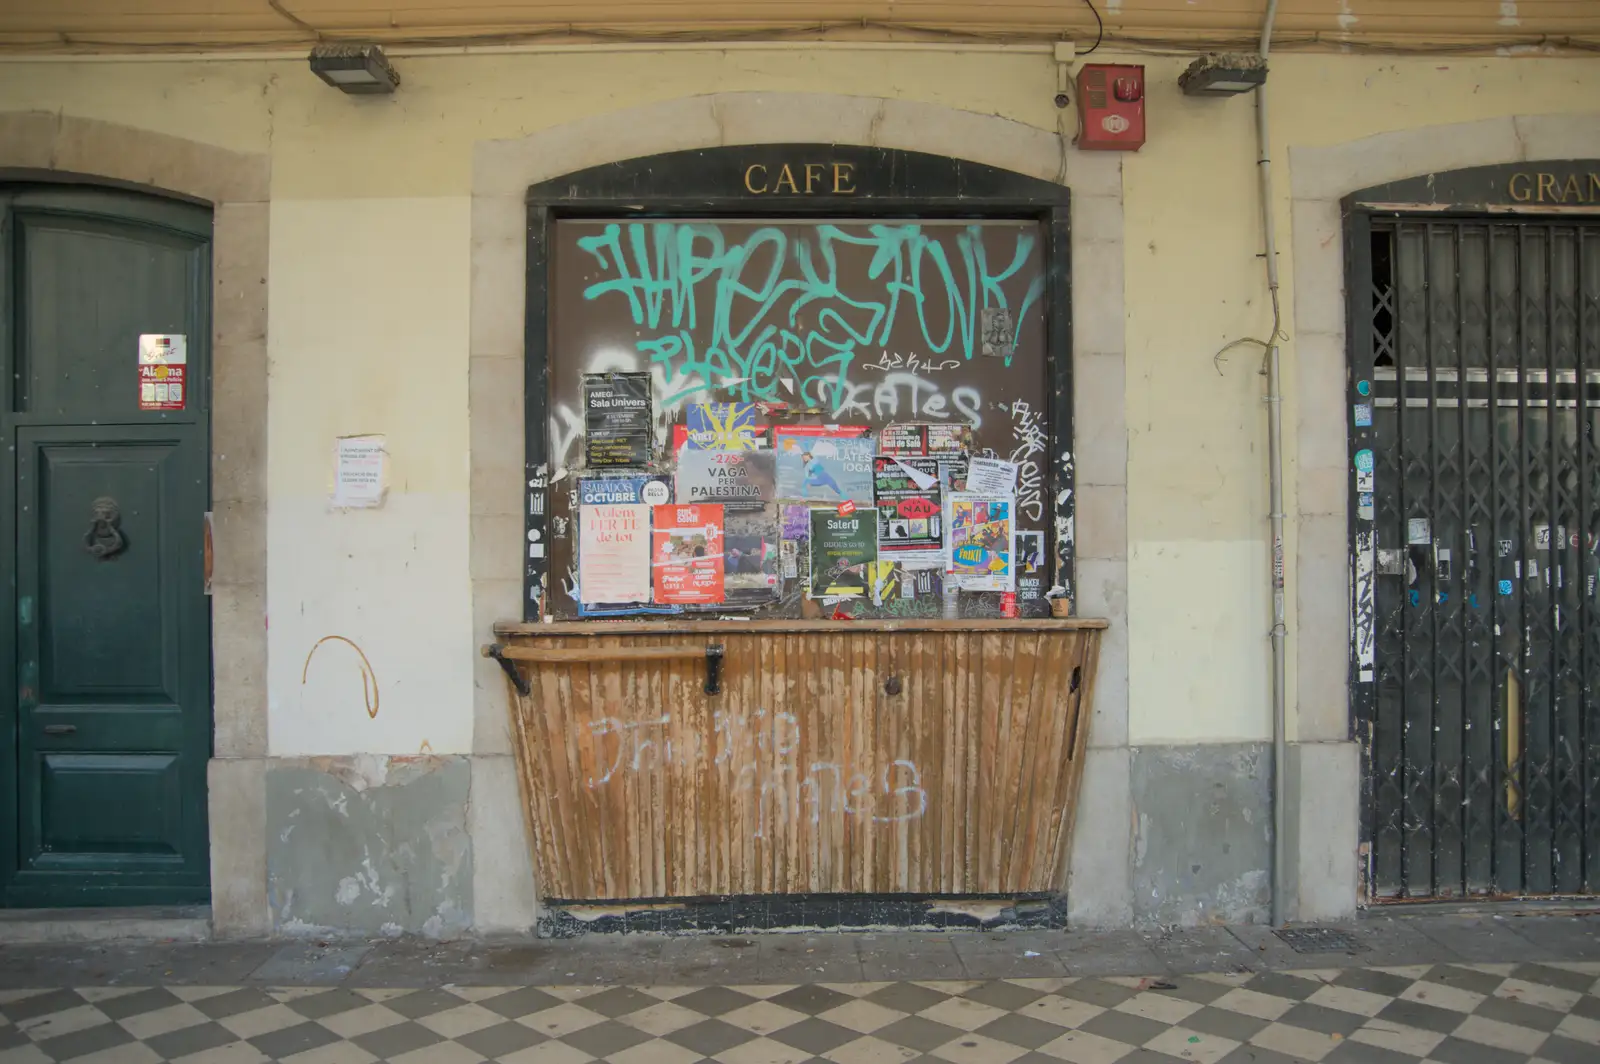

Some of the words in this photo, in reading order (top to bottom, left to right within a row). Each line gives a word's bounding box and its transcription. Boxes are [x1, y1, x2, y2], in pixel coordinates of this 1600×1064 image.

[744, 162, 857, 194] CAFE
[590, 399, 610, 408] Sala
[611, 398, 646, 407] Univers
[708, 467, 748, 477] VAGA
[842, 462, 872, 472] IOGA
[718, 477, 735, 485] PER
[691, 486, 761, 496] PALESTINA
[584, 492, 636, 503] OCTUBRE
[903, 505, 931, 513] NAU
